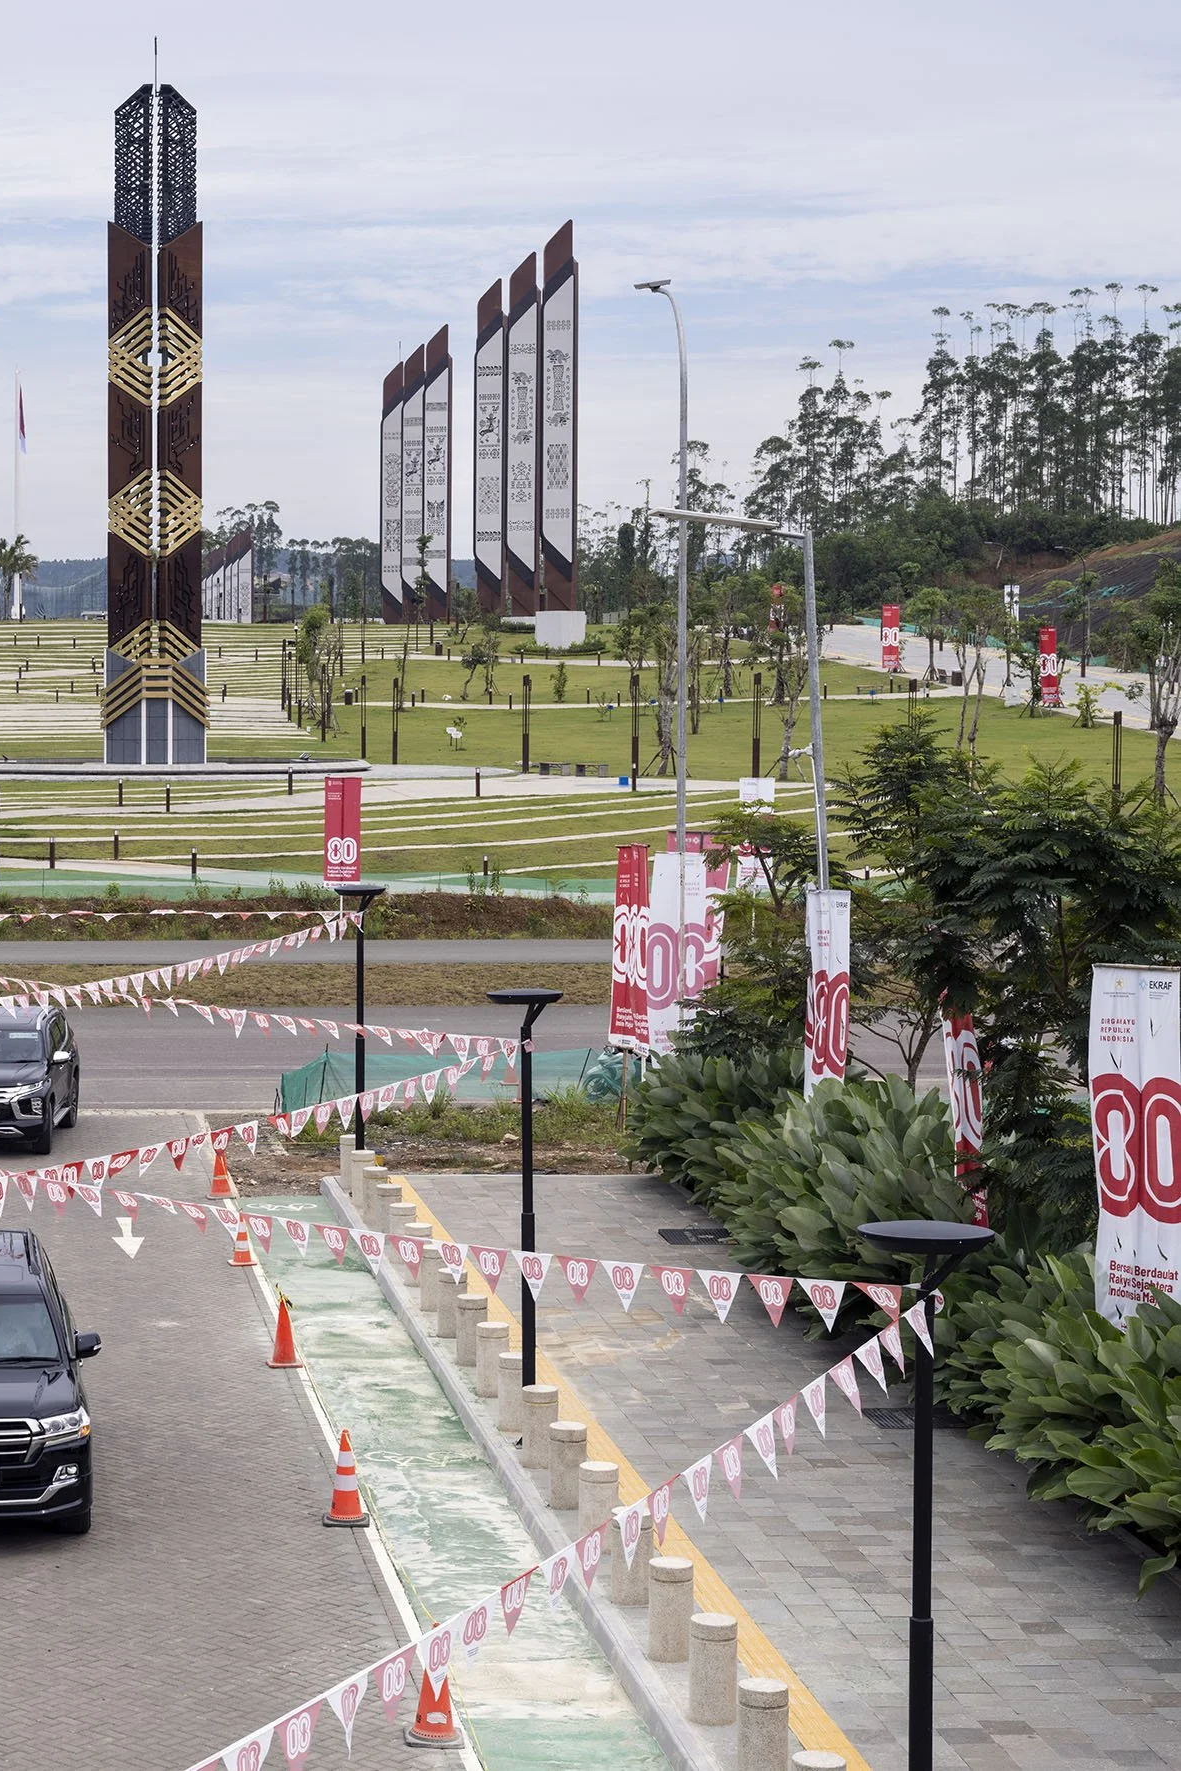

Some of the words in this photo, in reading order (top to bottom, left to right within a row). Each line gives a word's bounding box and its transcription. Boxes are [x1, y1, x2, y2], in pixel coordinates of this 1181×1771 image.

[882, 628, 900, 646] 80
[1040, 653, 1058, 676] 80
[328, 837, 357, 864] 80
[1149, 981, 1172, 990] EKRAF
[1092, 1072, 1180, 1224] 80
